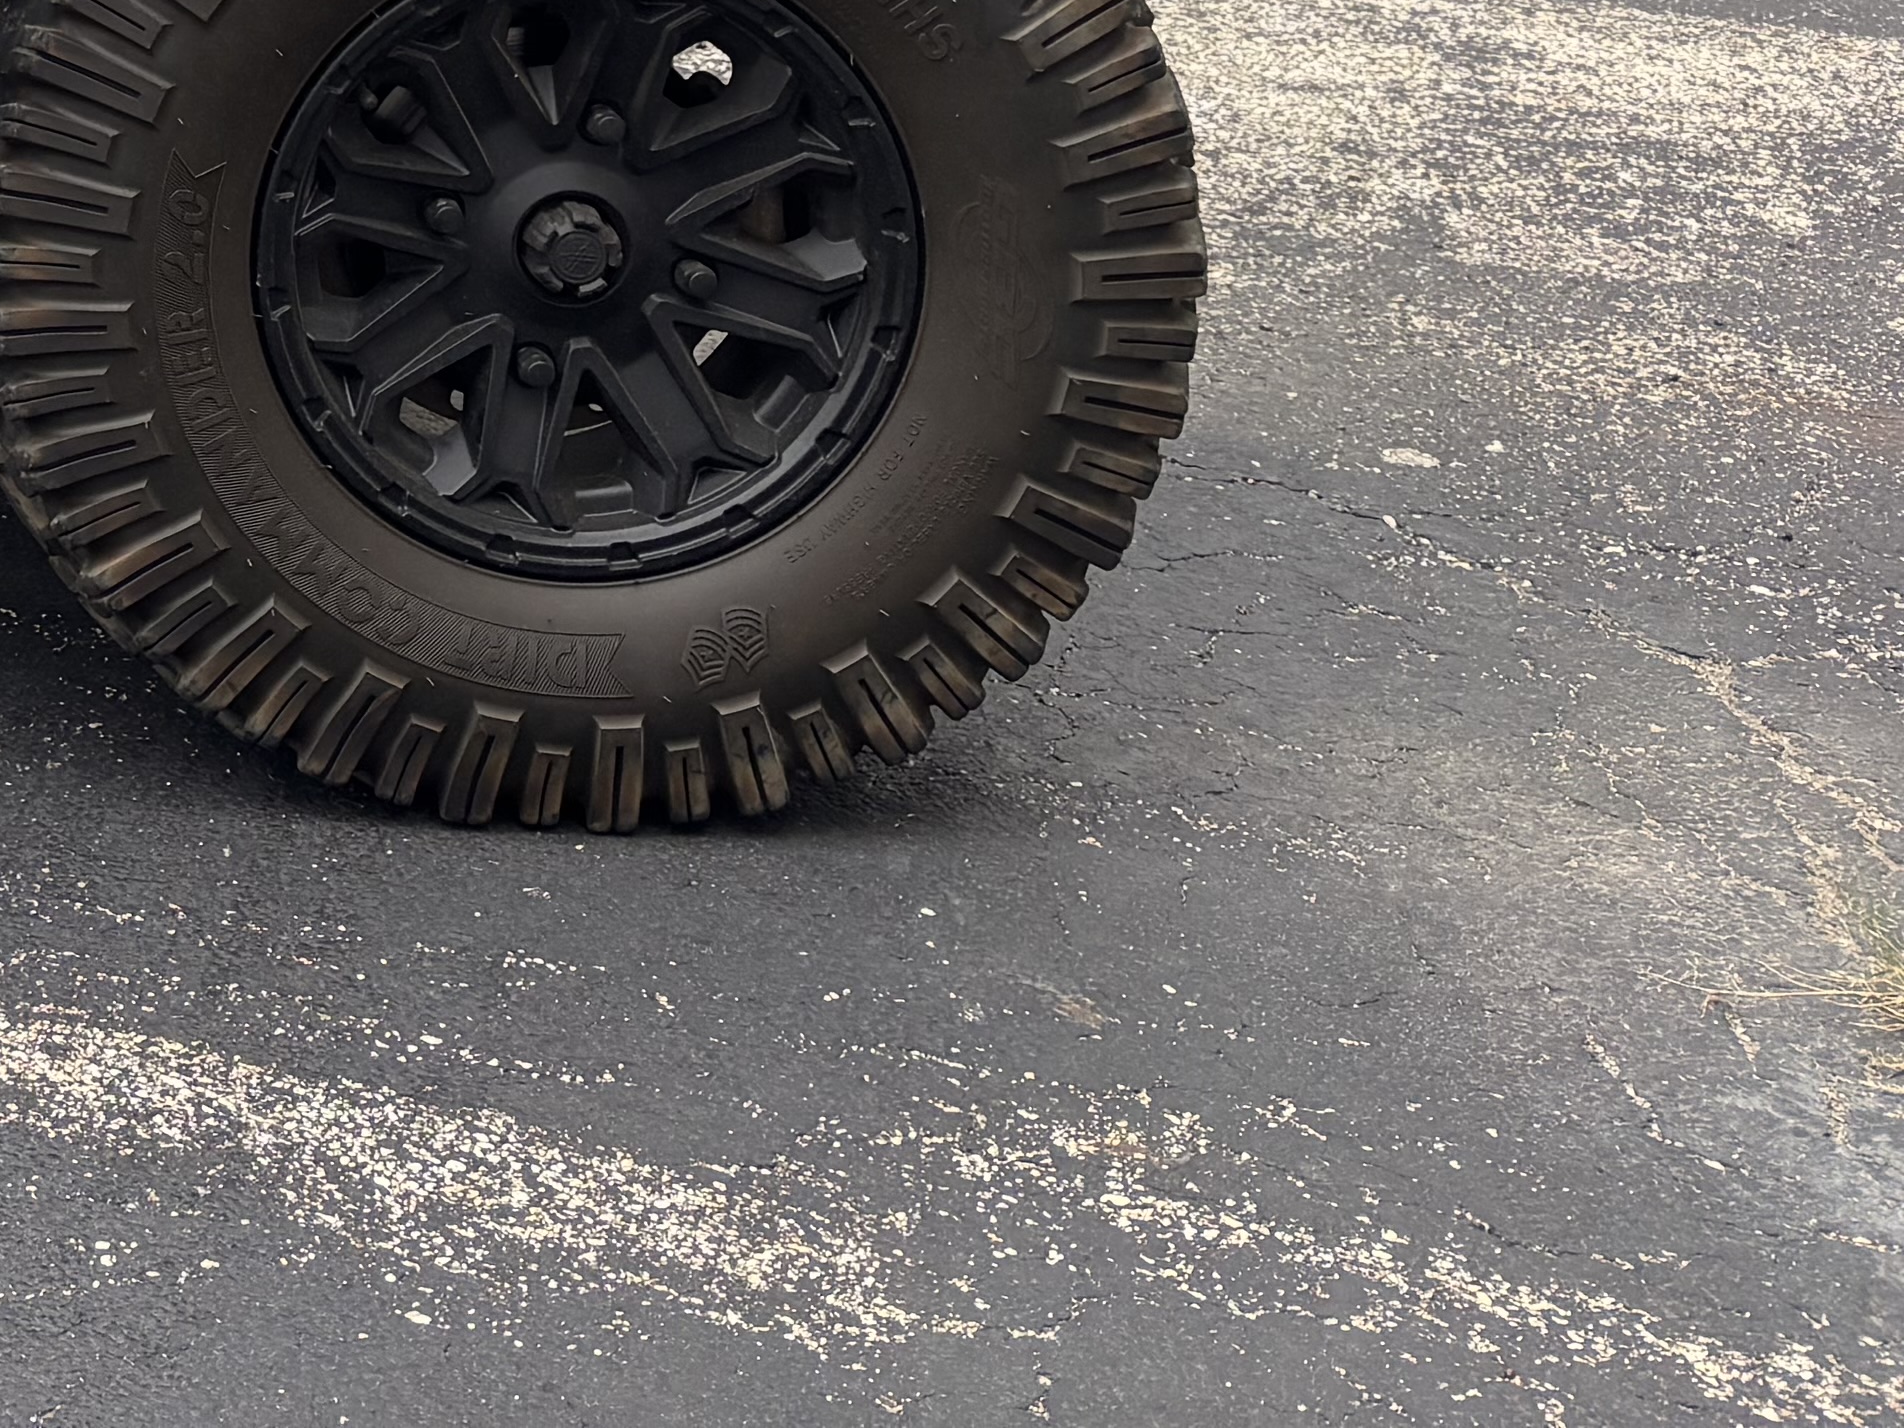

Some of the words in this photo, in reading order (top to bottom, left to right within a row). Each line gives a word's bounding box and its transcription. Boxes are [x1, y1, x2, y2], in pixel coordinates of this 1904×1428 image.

[166, 306, 420, 645] COMMANDER
[878, 449, 904, 481] FOR
[444, 622, 588, 690] DIRT
